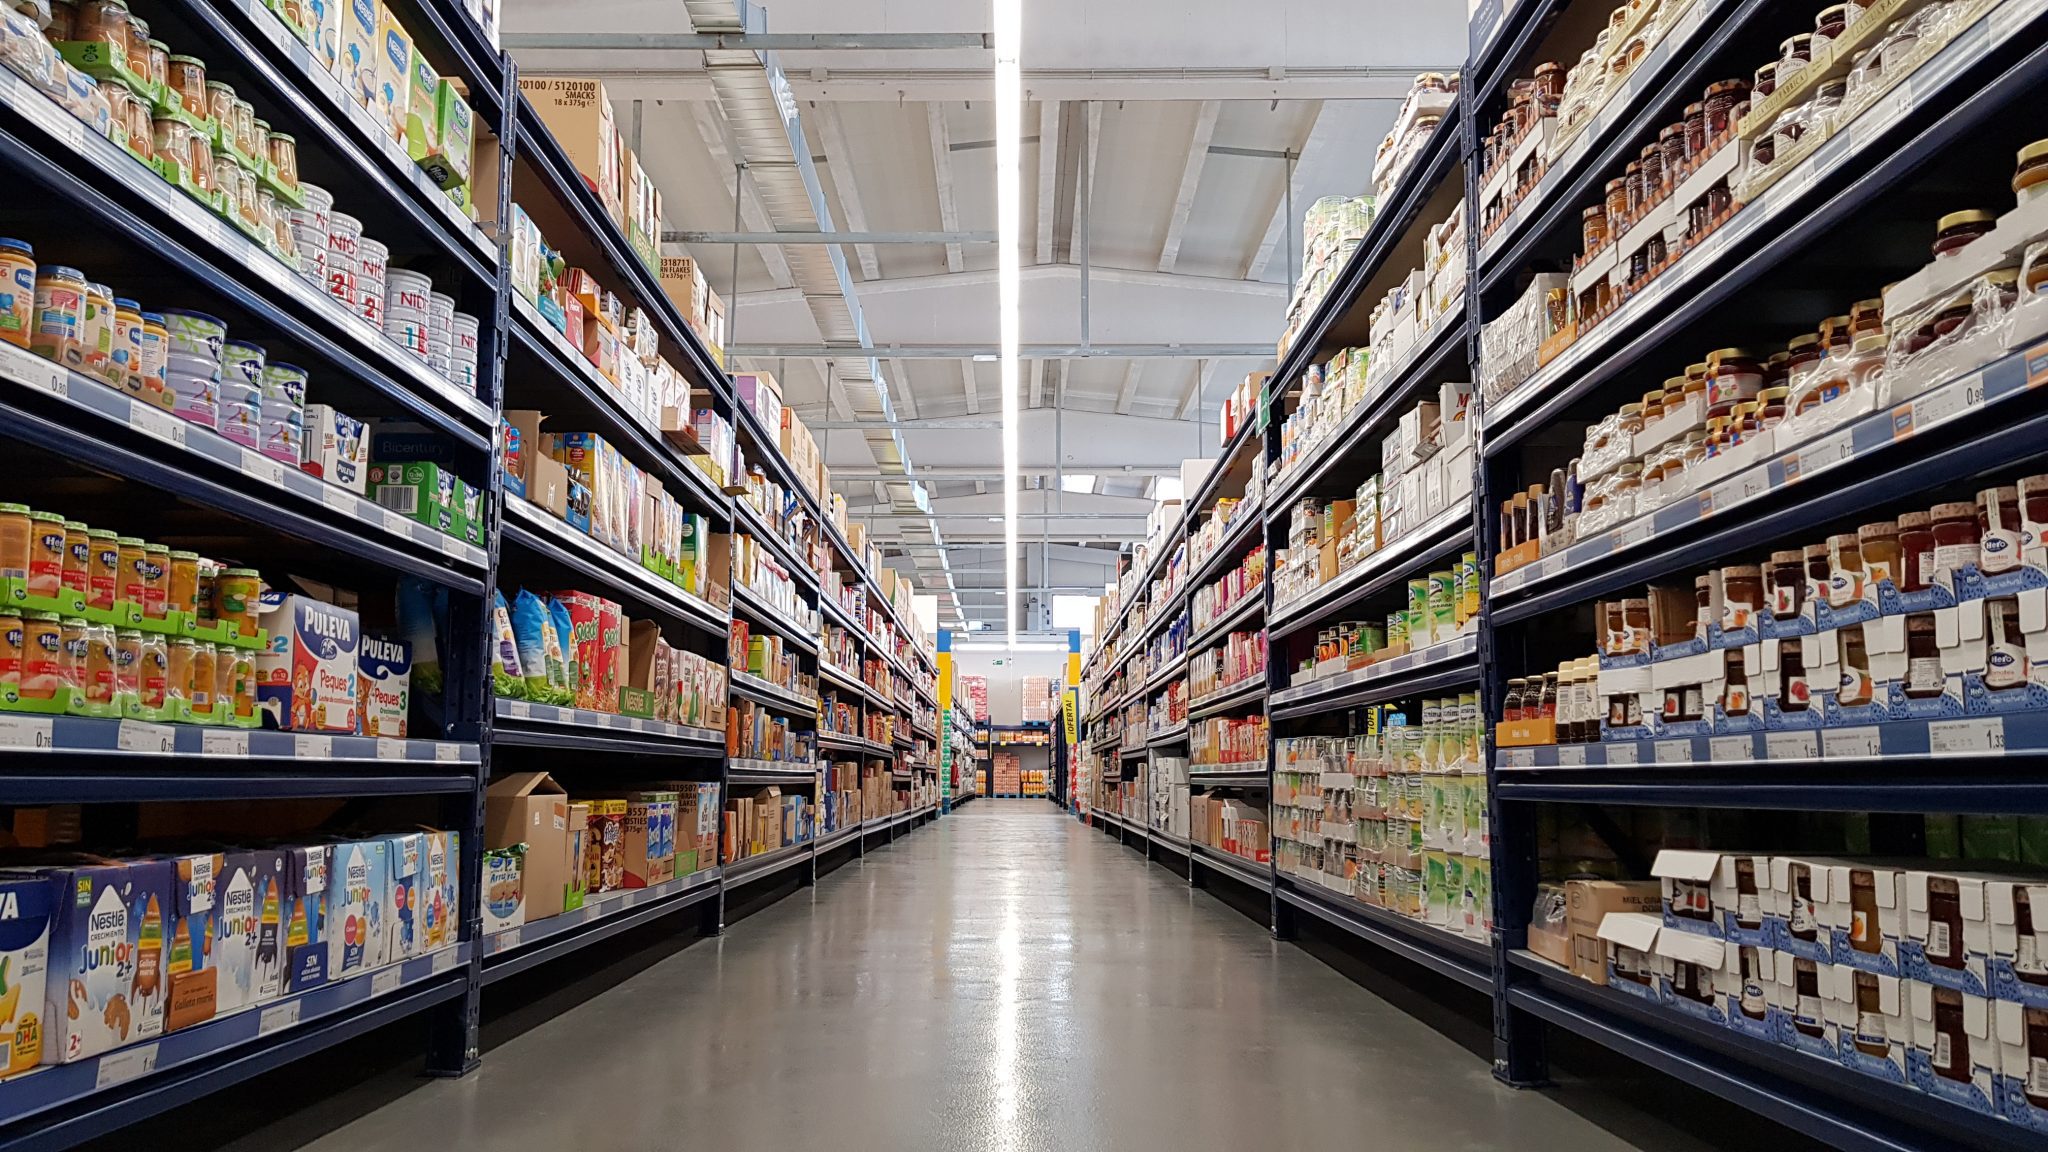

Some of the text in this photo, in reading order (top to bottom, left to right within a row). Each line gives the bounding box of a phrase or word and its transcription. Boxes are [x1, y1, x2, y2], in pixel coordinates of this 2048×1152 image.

[554, 81, 596, 92] 5120100
[565, 91, 596, 100] SMACKS
[1986, 541, 2006, 550] Hero
[304, 606, 351, 642] PULEVA
[361, 634, 404, 664] PULEVA
[320, 668, 355, 697] Peques 2
[375, 687, 407, 711] Peques 3
[1067, 699, 1075, 735] ¡OFERTA!
[78, 880, 92, 892] SIN
[187, 879, 217, 901] Junior
[341, 885, 371, 908] Junior
[90, 929, 125, 942] CRECIMIENTO
[217, 914, 259, 942] Junior
[79, 940, 134, 975] Junior
[116, 960, 133, 978] 2+
[16, 1028, 38, 1046] DHA
